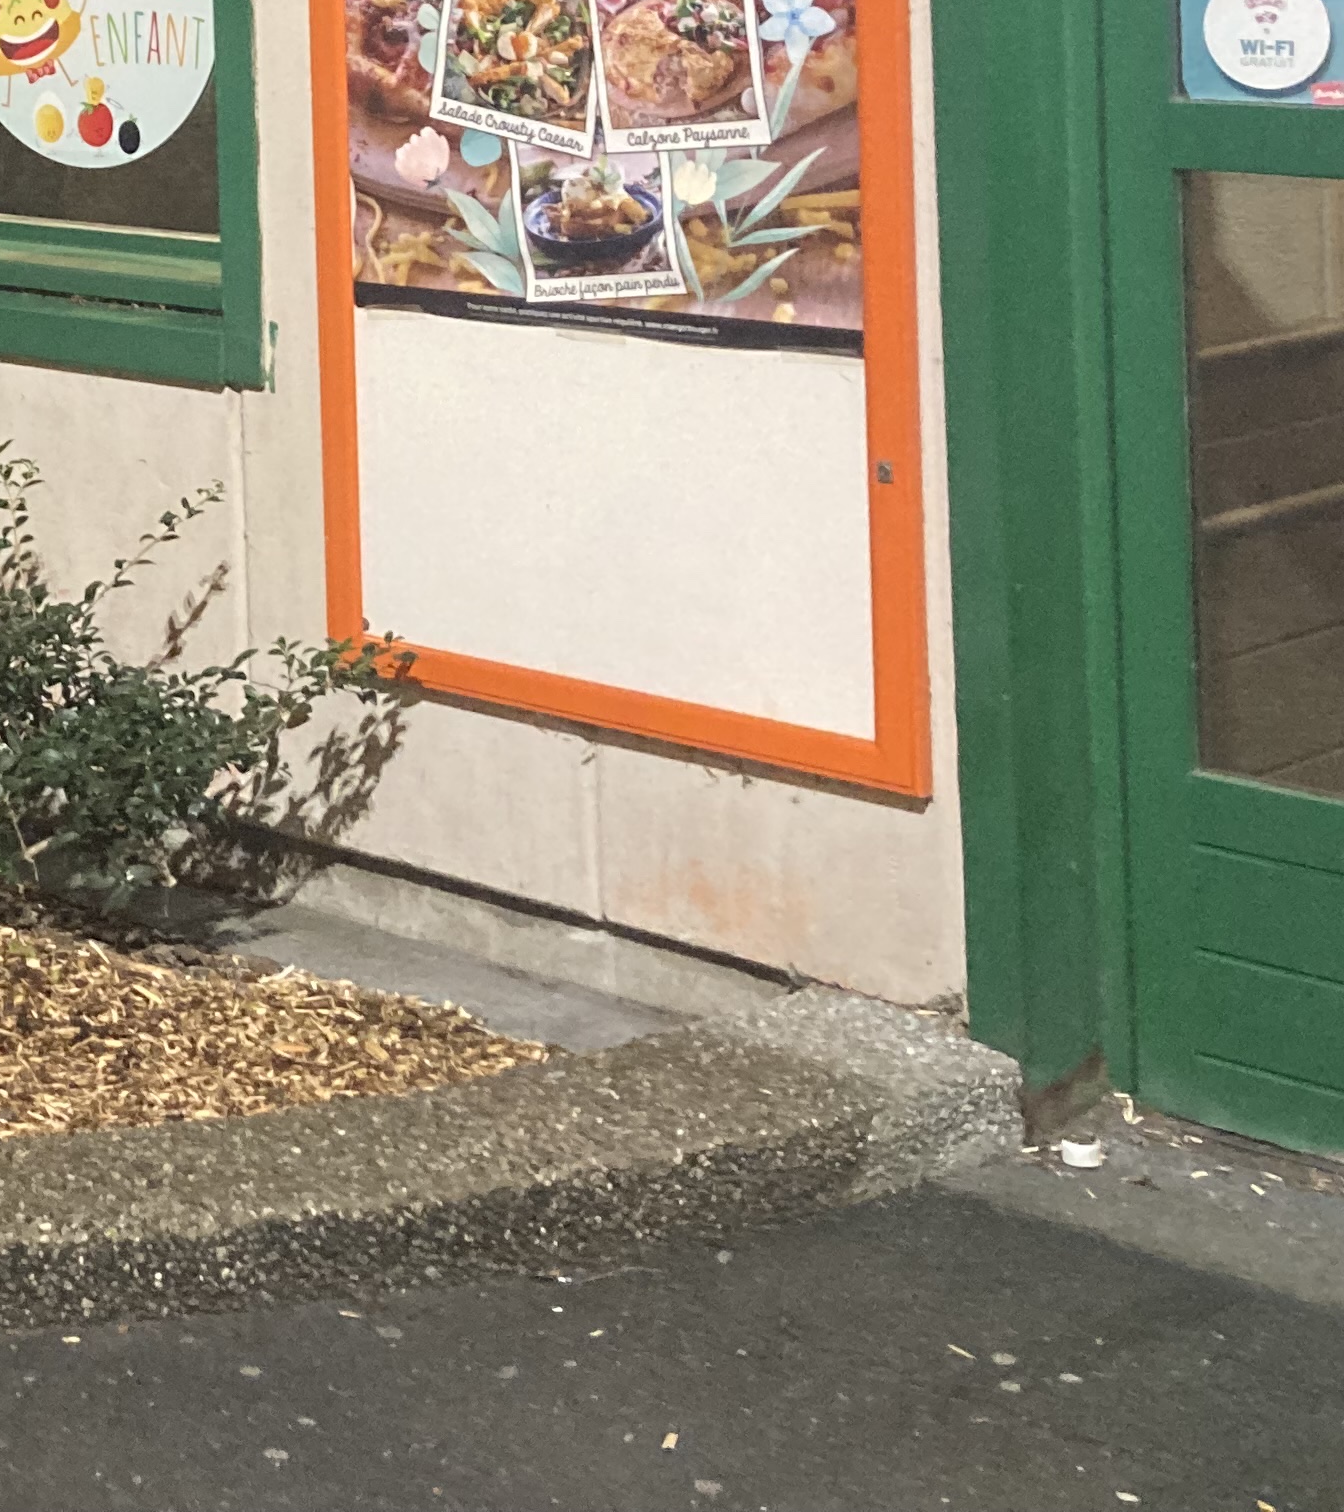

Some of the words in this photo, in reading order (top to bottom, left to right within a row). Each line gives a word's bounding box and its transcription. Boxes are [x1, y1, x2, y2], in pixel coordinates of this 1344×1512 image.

[90, 10, 205, 70] ENFANT
[1240, 39, 1295, 56] WI-FI
[437, 101, 483, 125] Salade
[484, 113, 535, 142] Crousty
[537, 127, 583, 152] Caesar
[626, 131, 680, 150] Calzone
[683, 127, 749, 148] Paysanne
[534, 283, 577, 297] Brioche
[579, 280, 613, 299] façon
[615, 279, 643, 296] pain
[644, 274, 681, 295] perdu
